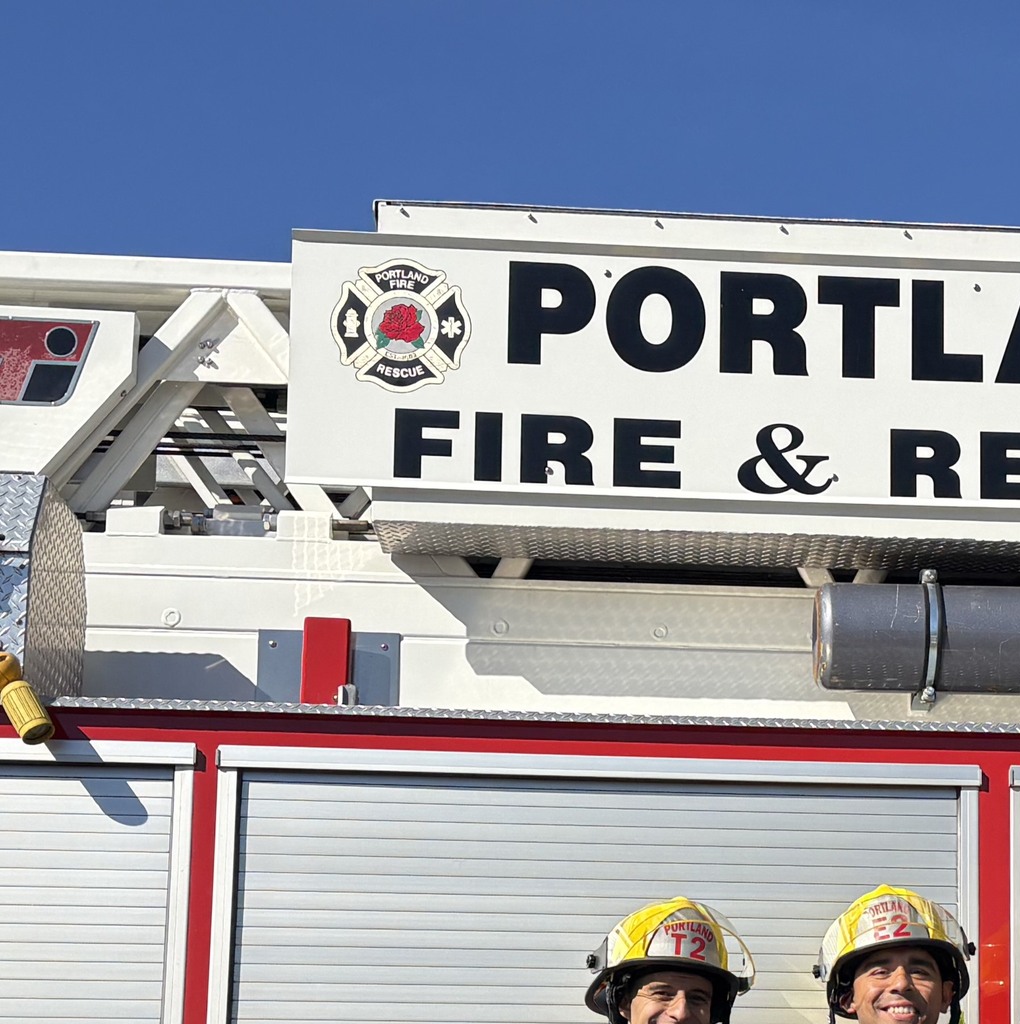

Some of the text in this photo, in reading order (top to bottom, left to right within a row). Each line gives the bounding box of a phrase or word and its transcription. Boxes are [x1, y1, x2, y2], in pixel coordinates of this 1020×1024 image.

[374, 269, 430, 285] PORTLAND
[389, 279, 416, 290] FIRE
[376, 363, 425, 378] RESCUE
[393, 407, 682, 489] FIRE
[737, 423, 833, 495] &
